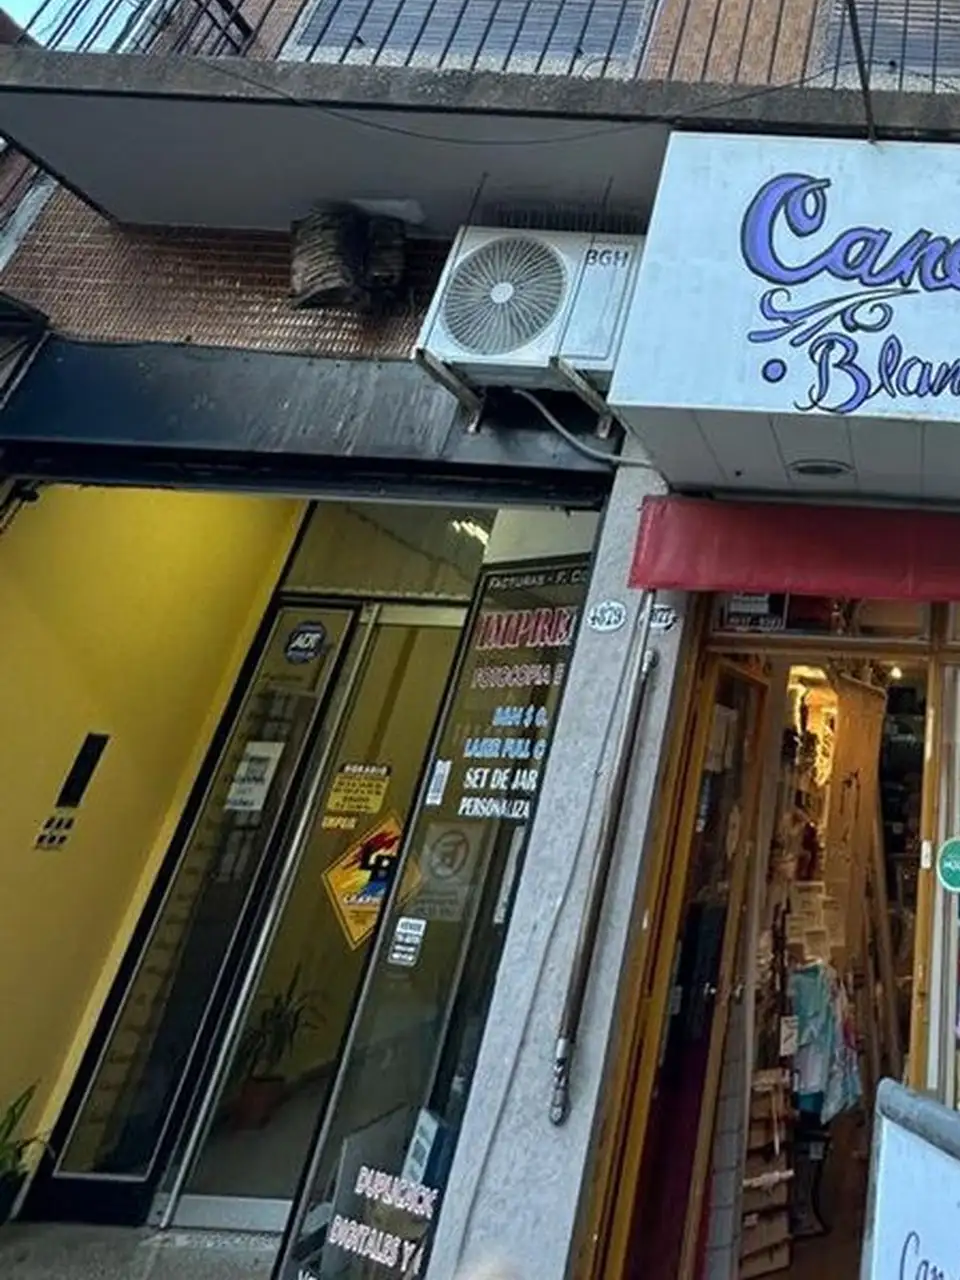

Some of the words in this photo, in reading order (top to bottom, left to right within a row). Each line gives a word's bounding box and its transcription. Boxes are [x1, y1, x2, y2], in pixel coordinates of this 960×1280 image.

[585, 248, 629, 268] BGH
[463, 767, 490, 790] SET
[489, 767, 511, 791] DE
